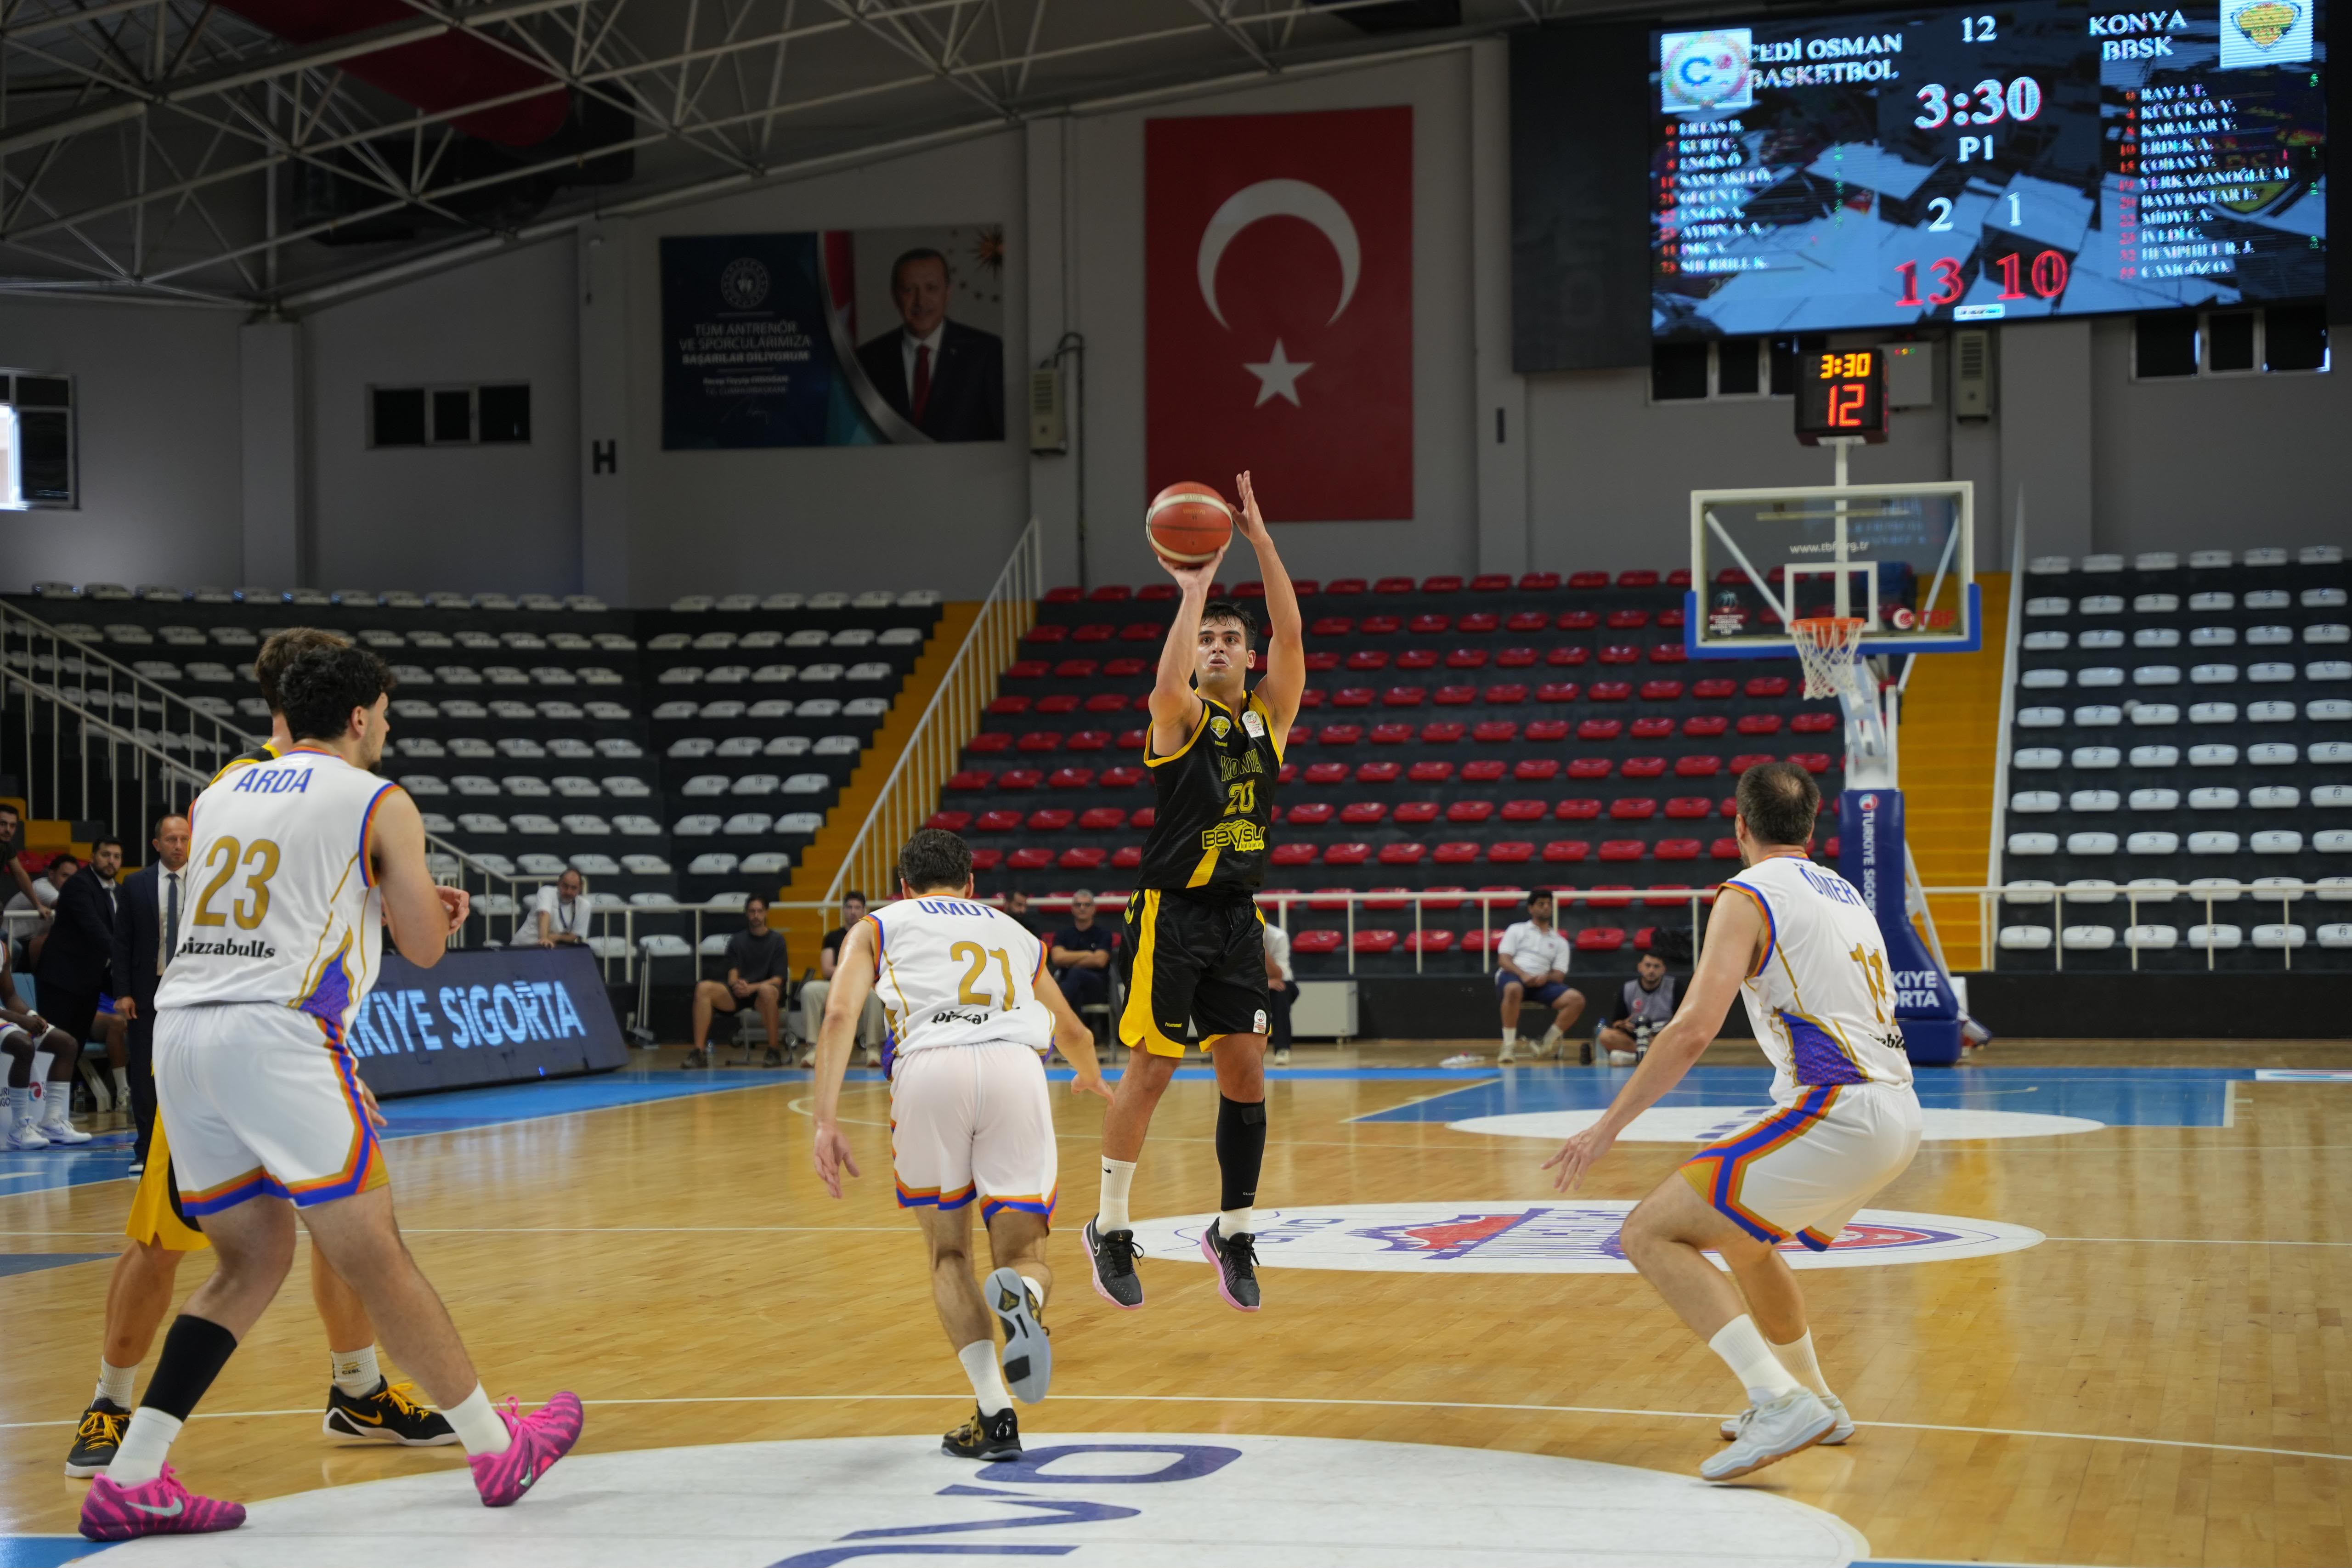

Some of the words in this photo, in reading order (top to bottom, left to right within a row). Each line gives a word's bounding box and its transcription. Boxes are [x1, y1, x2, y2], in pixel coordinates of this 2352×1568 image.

[1960, 16, 1997, 42] 12
[2089, 10, 2189, 36] KONYA
[1807, 33, 1902, 60] OSMAN
[2102, 36, 2174, 61] BBSK
[1747, 59, 1900, 89] BASKETBOL
[1914, 76, 2041, 129] 3:30
[1957, 135, 1994, 163] P1
[1928, 197, 1954, 232] 2
[2006, 192, 2021, 226] 1
[1894, 258, 1964, 306] 13
[1996, 250, 2068, 300] 10
[679, 339, 696, 351] VE
[698, 335, 812, 351] SPORCULARIMIZA
[726, 319, 798, 335] ANTRENÖR
[682, 352, 744, 366] BAŞARILAR
[1820, 352, 1871, 379] 3:30
[1828, 384, 1865, 427] 12
[593, 439, 616, 474] H
[233, 768, 313, 793] ARDA
[1221, 747, 1262, 781] KONYA
[1222, 779, 1255, 817] 20
[192, 835, 281, 930] 23
[1794, 863, 1860, 906] ÖMER
[916, 900, 995, 919] UMUT
[949, 940, 1015, 1012] 21
[439, 980, 587, 1049] SİGORTA
